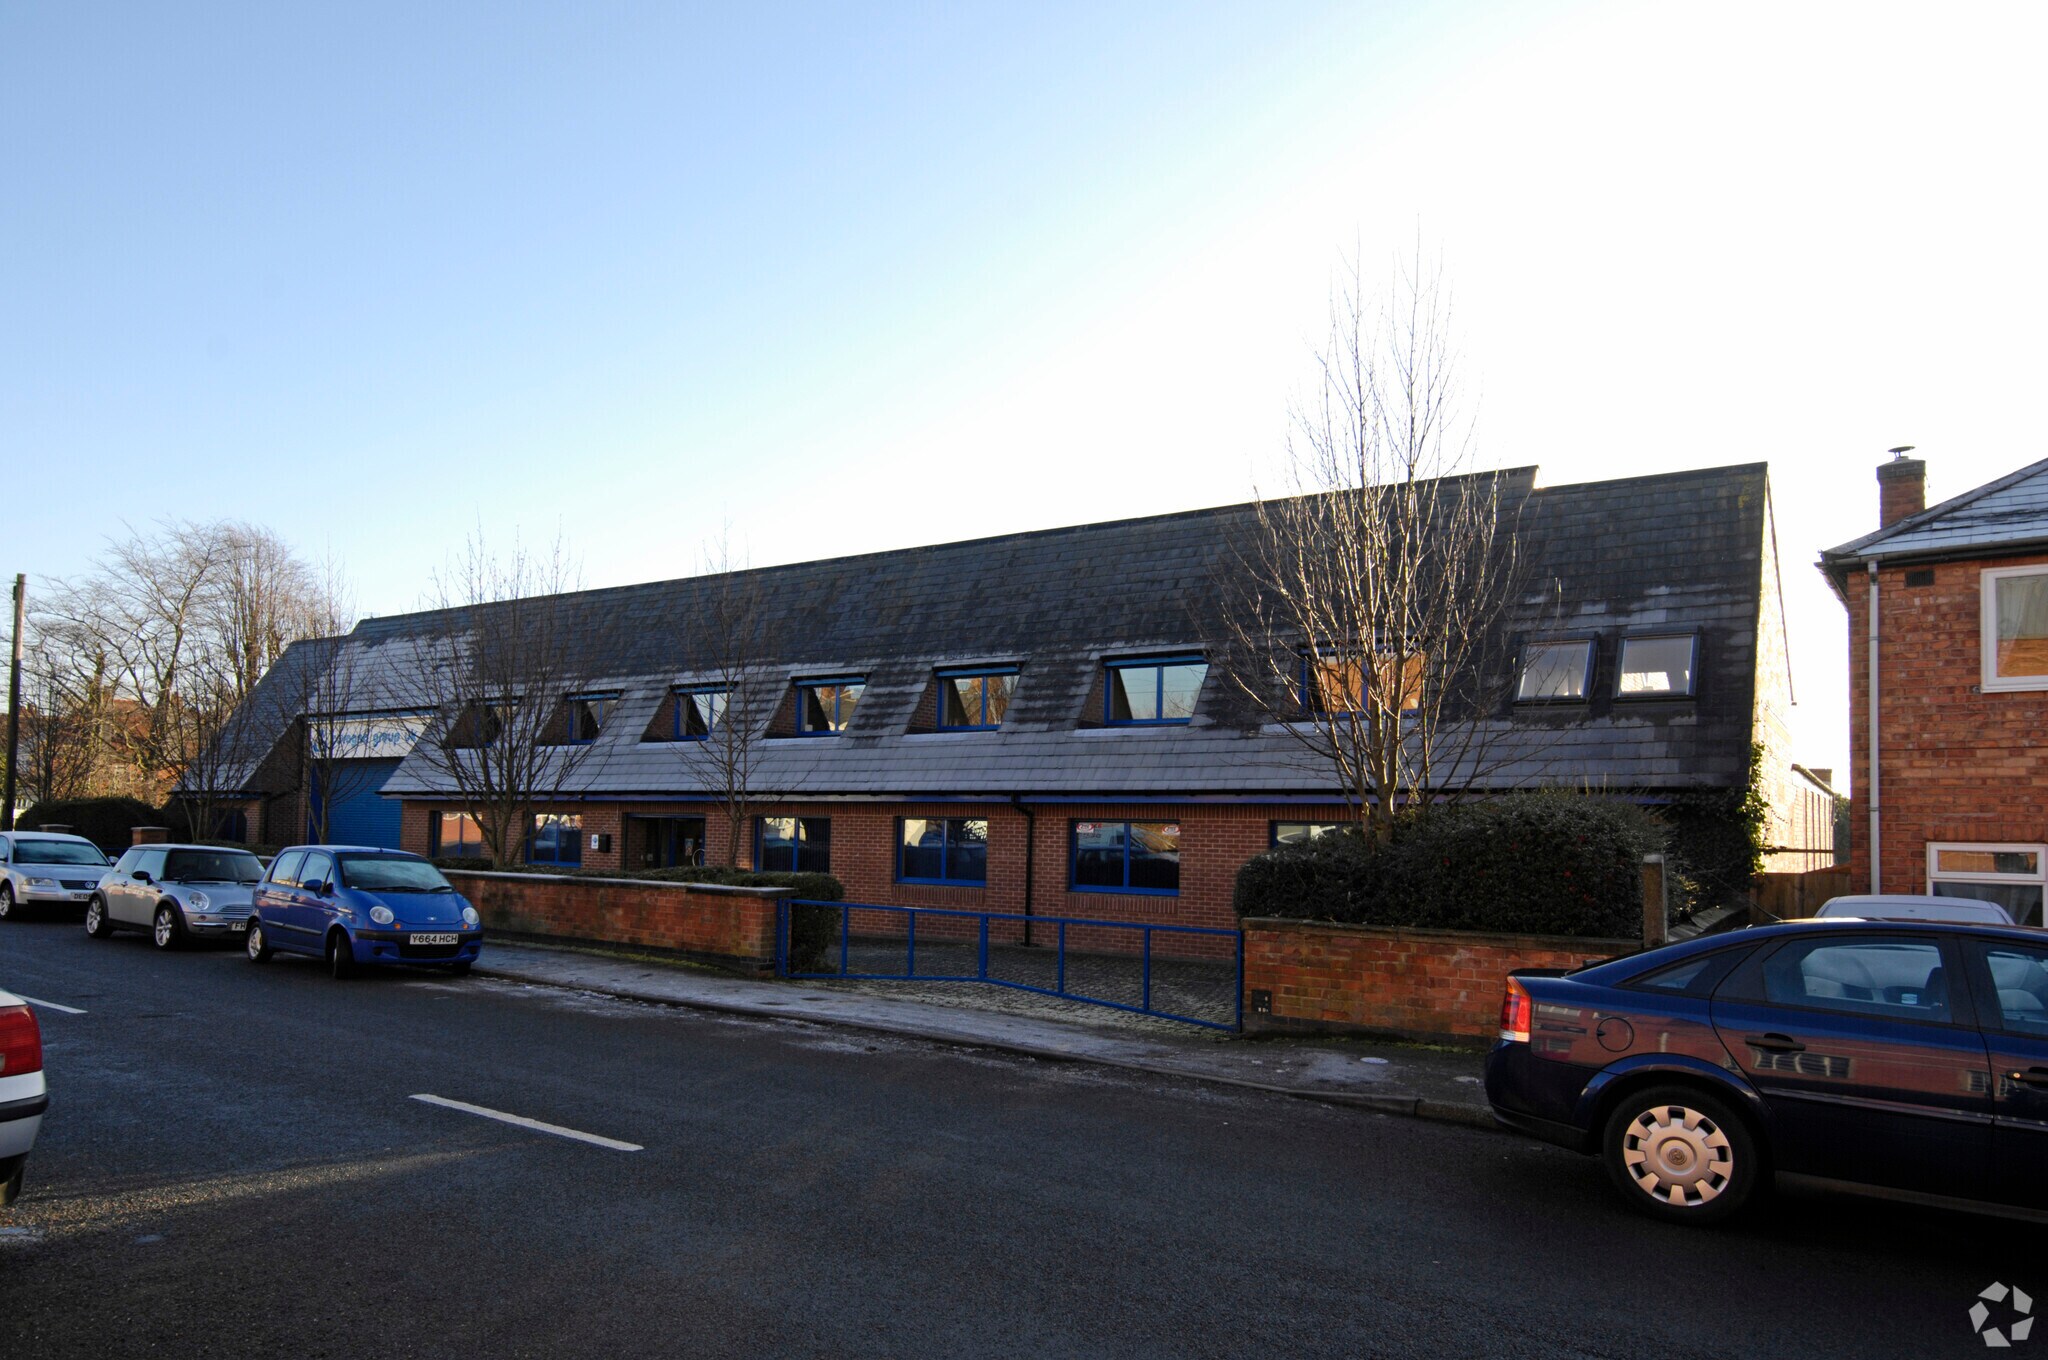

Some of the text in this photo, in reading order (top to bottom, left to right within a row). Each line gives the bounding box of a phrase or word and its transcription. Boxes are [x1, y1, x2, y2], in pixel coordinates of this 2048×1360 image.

[373, 732, 400, 747] group
[412, 934, 458, 943] Y664 HCH
